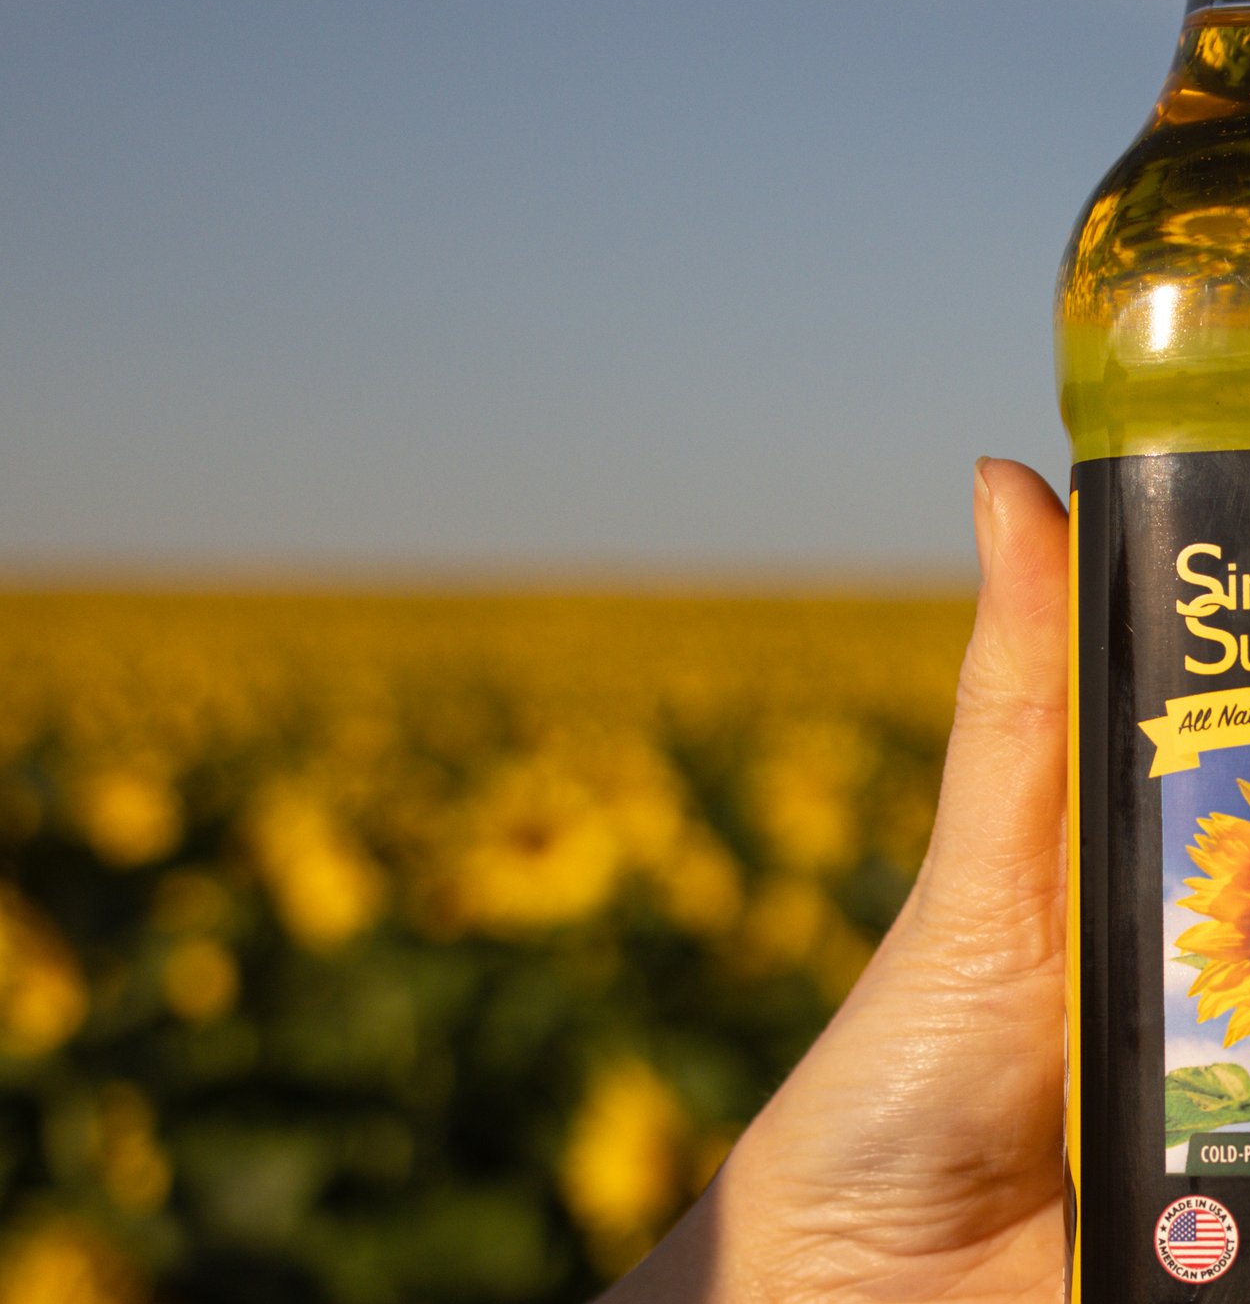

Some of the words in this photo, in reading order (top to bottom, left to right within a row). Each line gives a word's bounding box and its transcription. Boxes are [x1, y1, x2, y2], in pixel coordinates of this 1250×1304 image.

[1178, 710, 1212, 734] All
[1164, 1199, 1193, 1222] MADE
[1195, 1199, 1207, 1208] IN
[1208, 1202, 1228, 1222] USA
[1158, 1238, 1198, 1279] AMERICAN
[1200, 1238, 1235, 1279] PRODUCT
